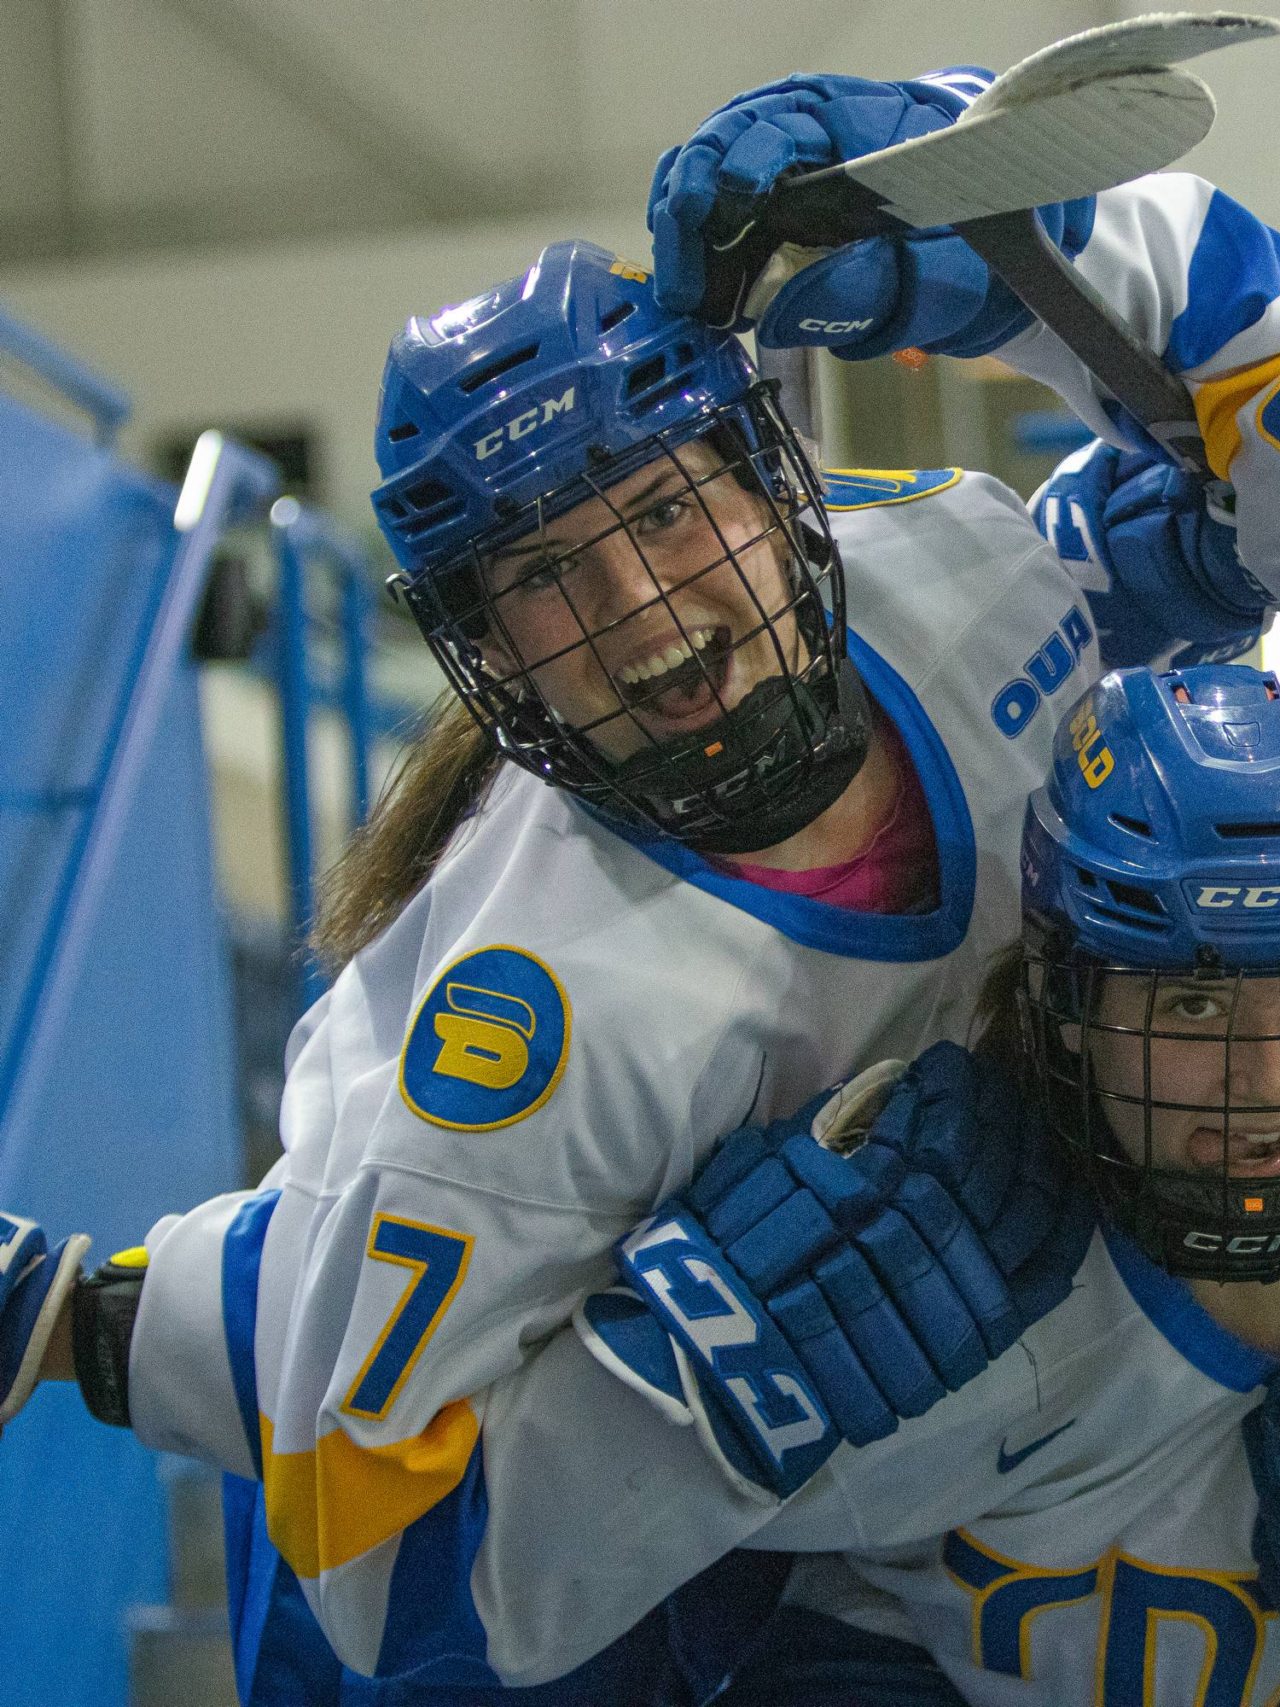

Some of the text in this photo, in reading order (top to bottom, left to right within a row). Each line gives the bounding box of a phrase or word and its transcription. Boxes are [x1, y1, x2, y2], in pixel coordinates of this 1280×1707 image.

[798, 316, 873, 334] CCM
[472, 387, 576, 463] CCM
[991, 604, 1093, 740] OUA
[339, 1211, 477, 1421] 7
